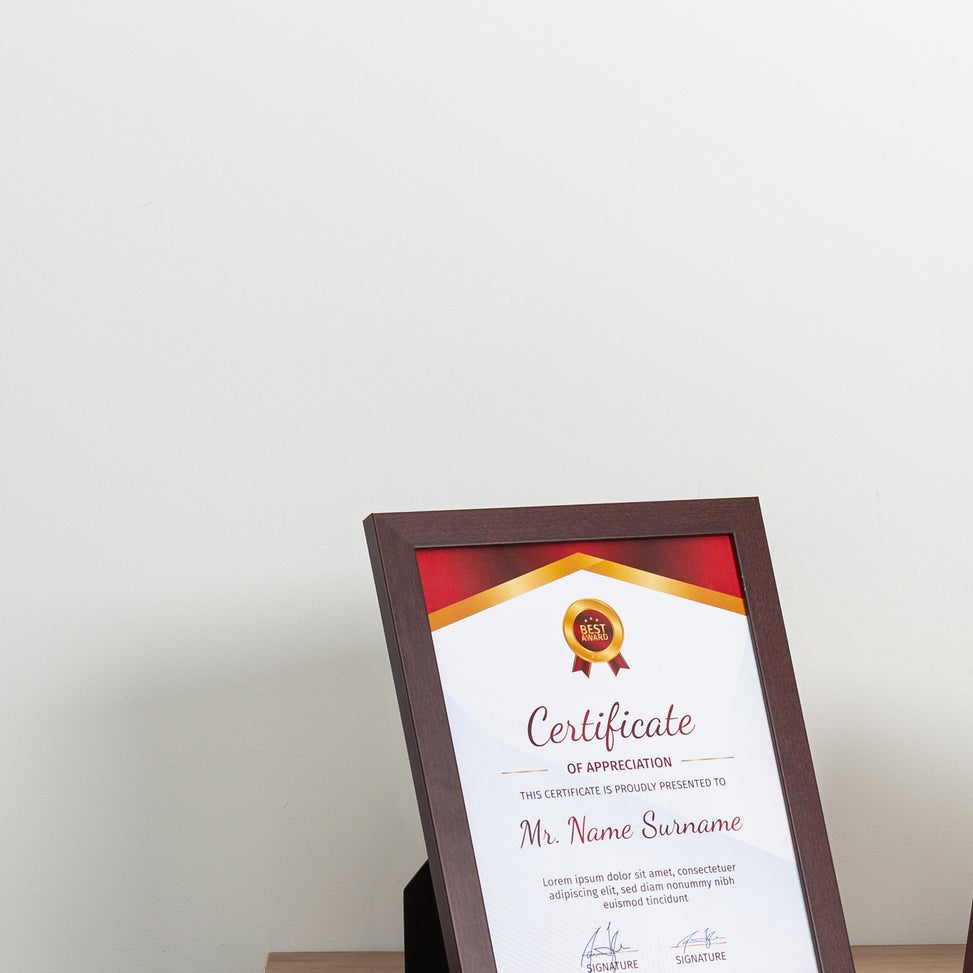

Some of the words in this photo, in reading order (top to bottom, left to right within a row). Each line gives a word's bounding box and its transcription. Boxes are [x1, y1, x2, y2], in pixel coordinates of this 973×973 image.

[580, 624, 606, 635] BEST
[581, 632, 608, 642] AWARD
[528, 702, 695, 752] Certificate
[567, 762, 583, 774] OF
[587, 757, 672, 773] APPRECIATION
[520, 790, 542, 800] THIS
[544, 786, 600, 798] CERTIFICATE
[603, 786, 612, 794] IS
[615, 782, 657, 794] PROUDLY
[660, 778, 711, 791] PRESENTED
[714, 778, 726, 786] TO
[520, 819, 559, 849] Mr.
[568, 816, 634, 845] Name
[642, 810, 743, 839] Surname
[542, 877, 572, 887] Lorem
[575, 873, 604, 888] ipsum
[607, 871, 632, 882] dolor
[634, 869, 647, 879] sit
[649, 868, 675, 879] amet,
[678, 863, 736, 876] consectetuer
[549, 886, 598, 900] adipiscing
[600, 885, 619, 896] elit,
[621, 884, 638, 894] sed
[640, 881, 664, 892] diam
[666, 880, 712, 890] nonummy
[714, 877, 735, 886] nibh
[603, 897, 644, 909] euismod
[646, 894, 689, 906] tincidunt
[586, 959, 639, 973] SIGNATURE
[675, 952, 727, 964] SIGNATURE
